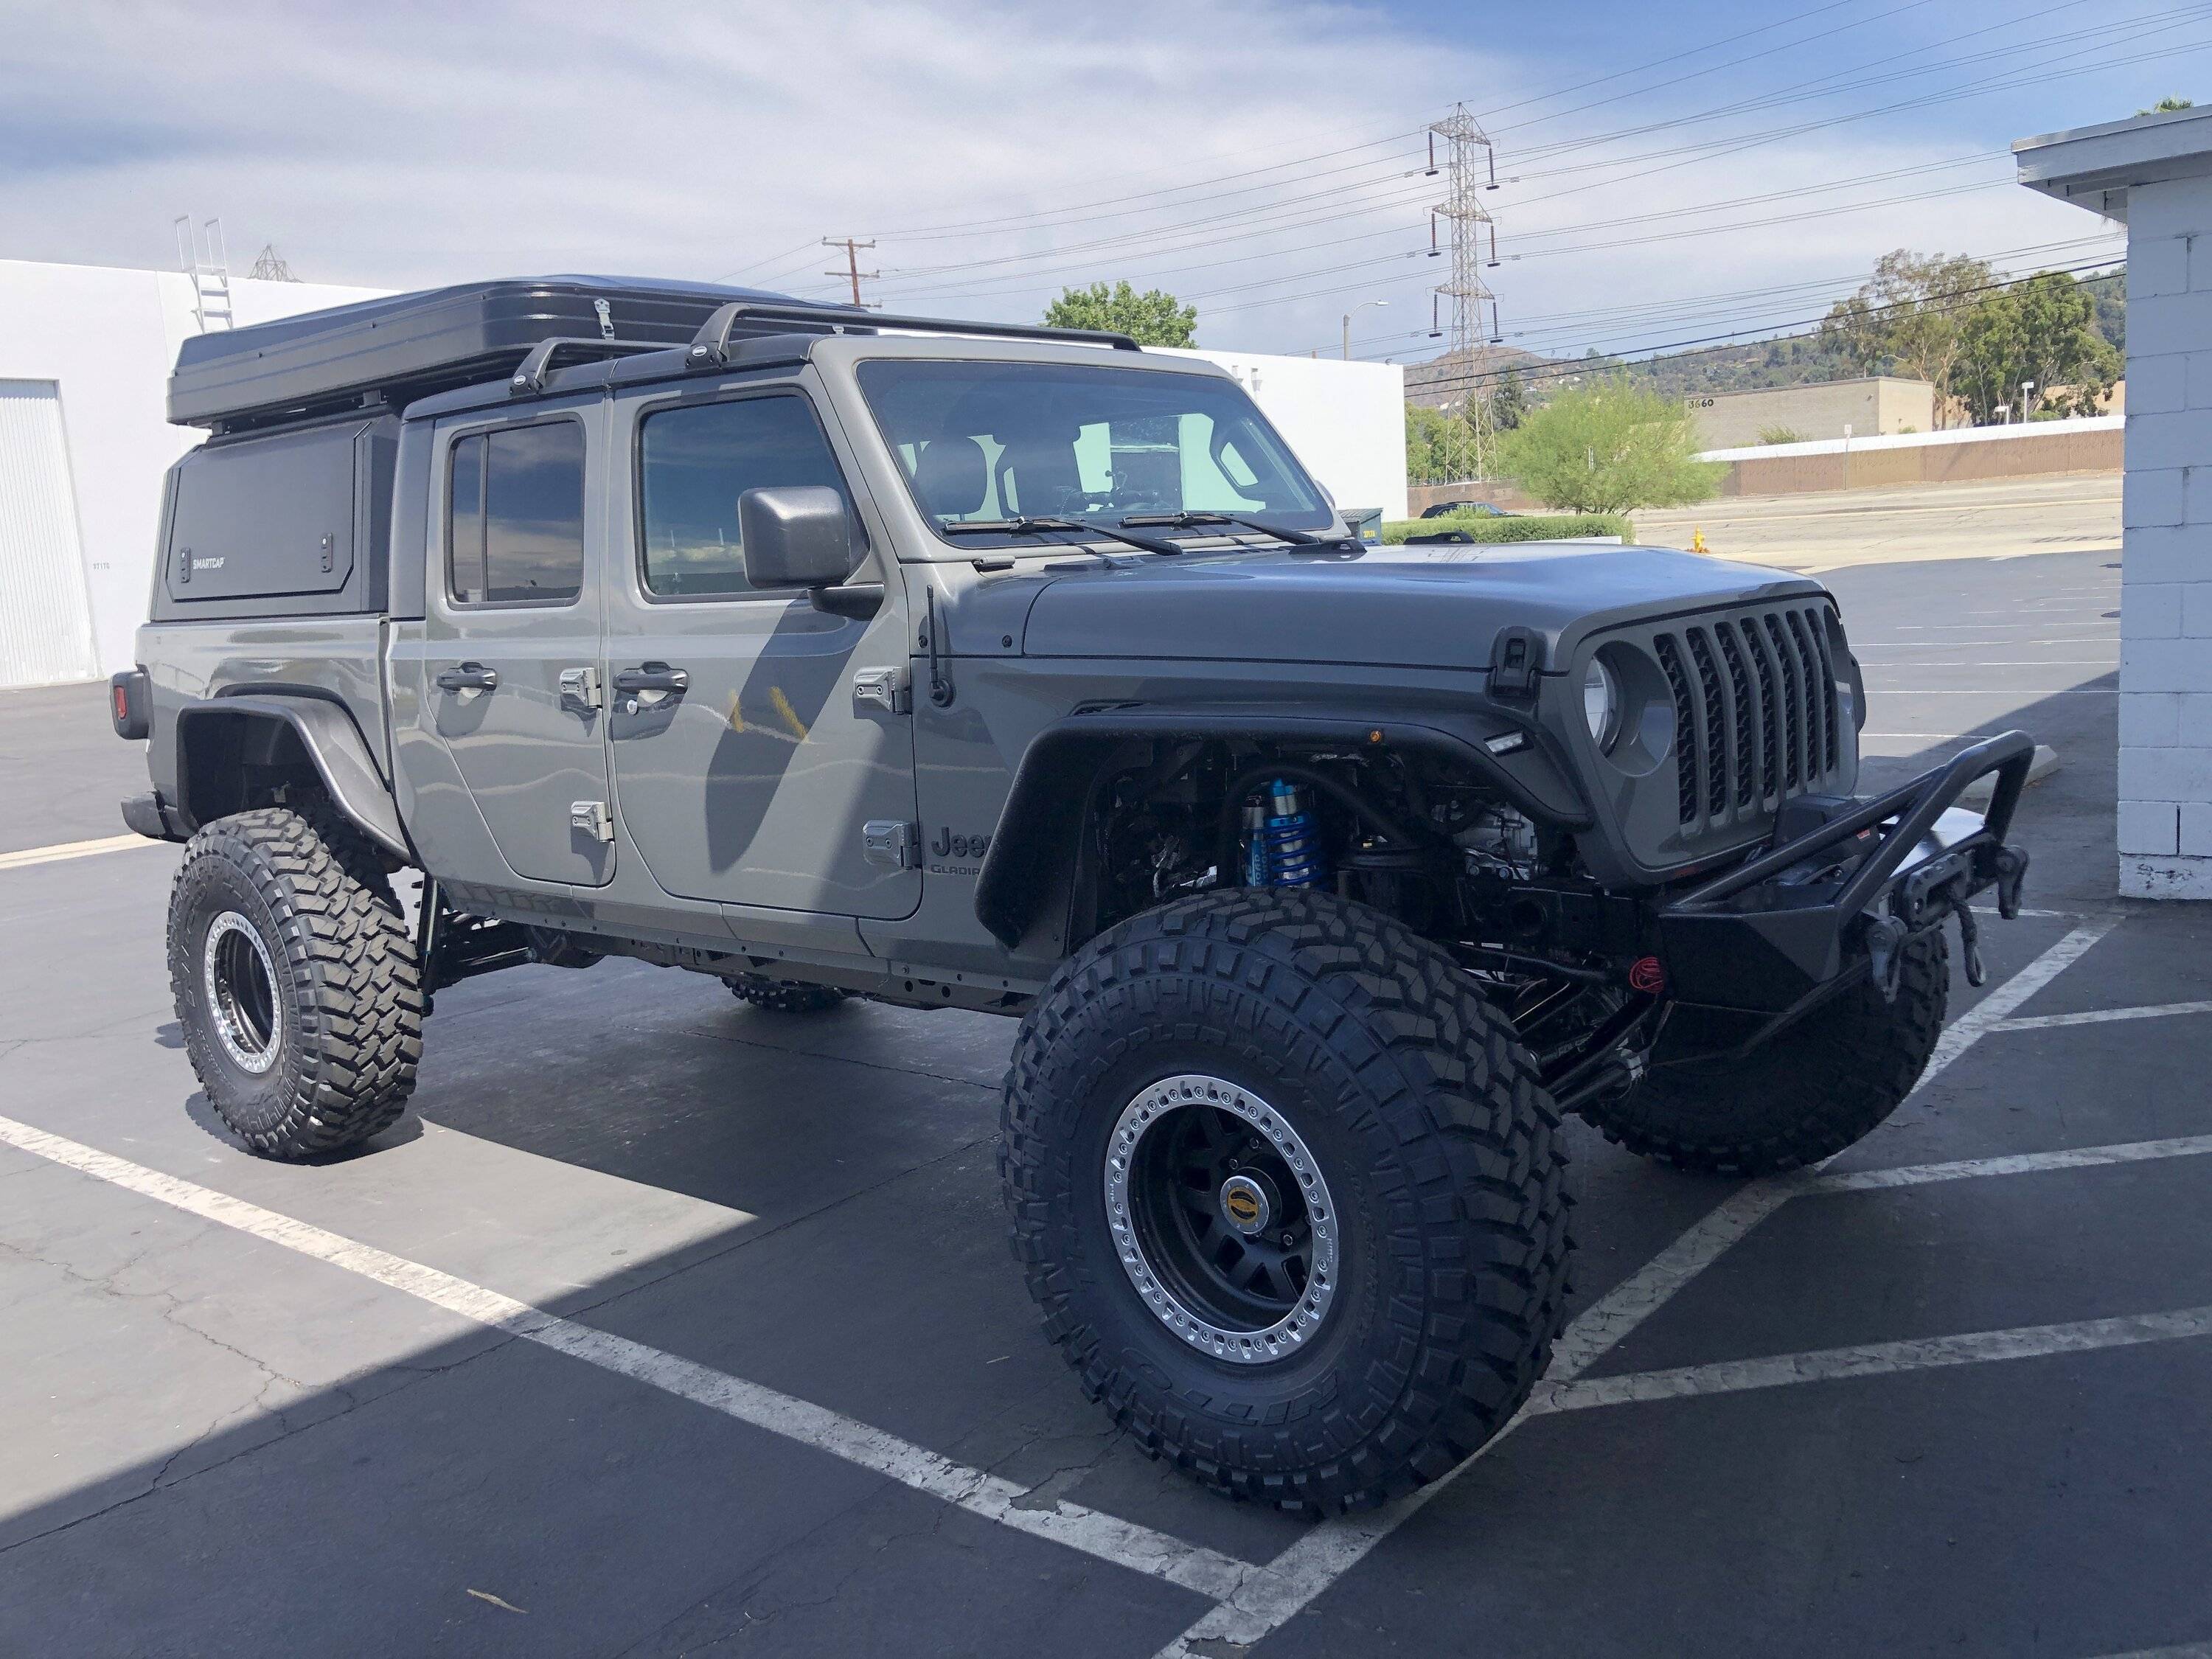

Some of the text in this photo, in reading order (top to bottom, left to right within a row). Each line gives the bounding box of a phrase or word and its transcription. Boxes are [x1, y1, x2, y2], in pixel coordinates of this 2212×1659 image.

[1688, 399, 1714, 409] 3660
[192, 557, 224, 570] SMARTCAP
[931, 864, 981, 875] GLADIA
